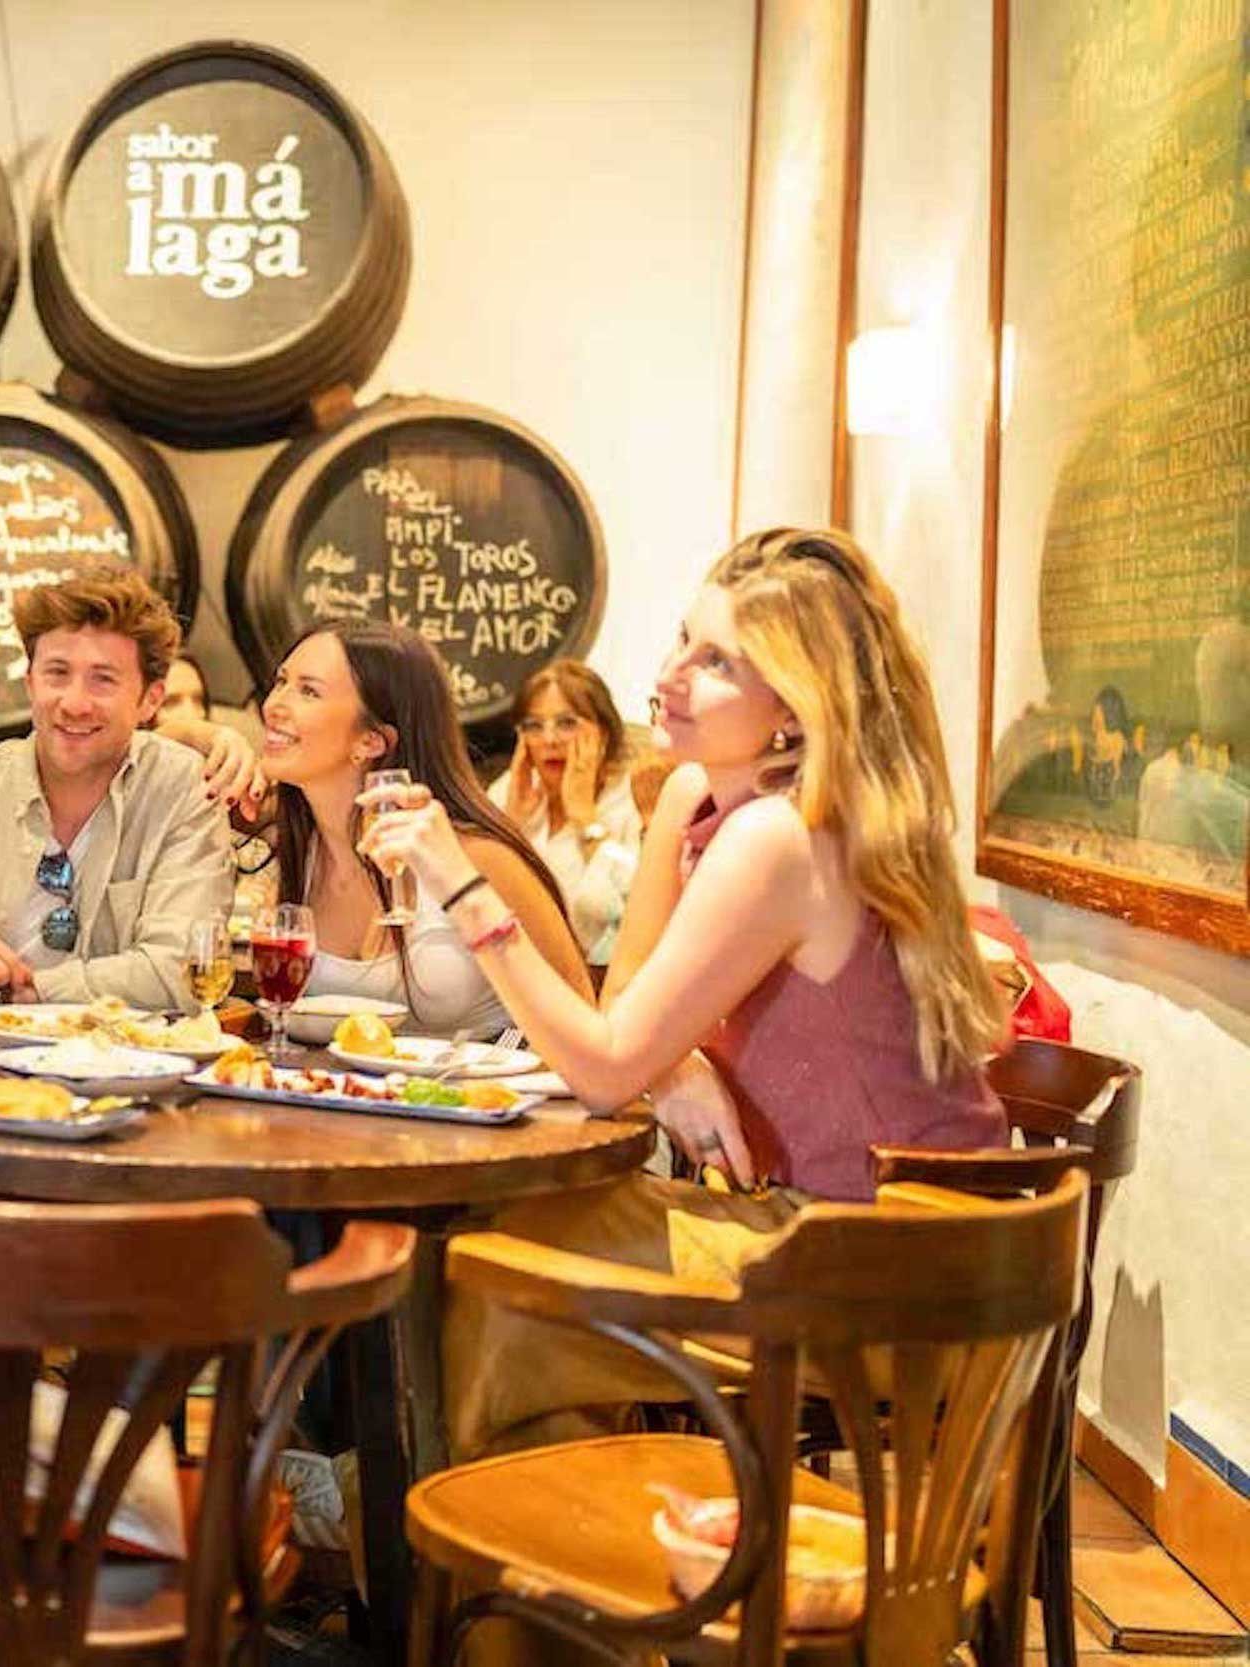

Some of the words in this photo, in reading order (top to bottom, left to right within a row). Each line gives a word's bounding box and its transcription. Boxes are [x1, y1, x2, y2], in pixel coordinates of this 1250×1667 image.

[127, 123, 219, 159] sabor
[126, 160, 154, 192] a
[154, 134, 311, 222] má
[125, 197, 310, 300] laga
[391, 546, 438, 571] LOS
[453, 539, 537, 578] TOROS
[417, 572, 577, 614] FLAMENCO
[419, 612, 466, 643] EL
[470, 611, 562, 658] AMOR
